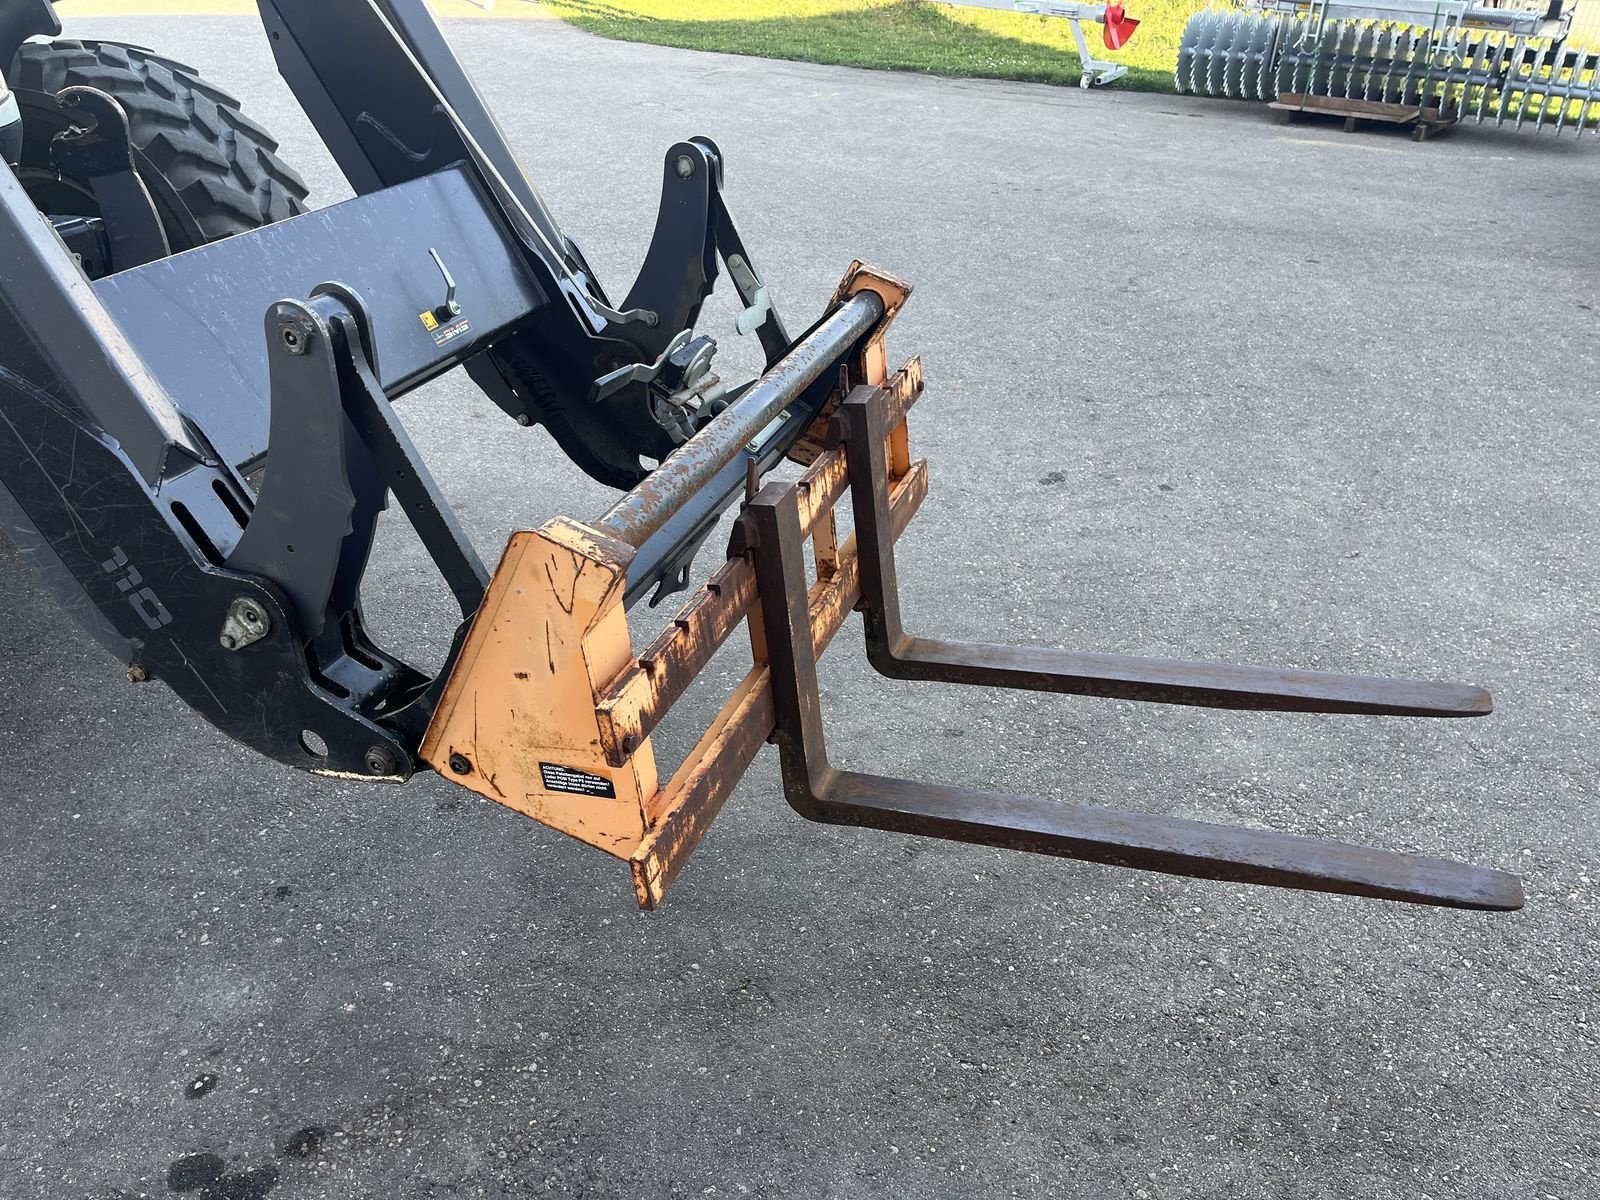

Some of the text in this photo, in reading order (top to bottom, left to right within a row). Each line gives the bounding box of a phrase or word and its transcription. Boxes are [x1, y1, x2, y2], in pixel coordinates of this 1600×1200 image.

[443, 319, 469, 339] SMS
[101, 545, 173, 630] 110
[556, 771, 584, 779] Palettengabel
